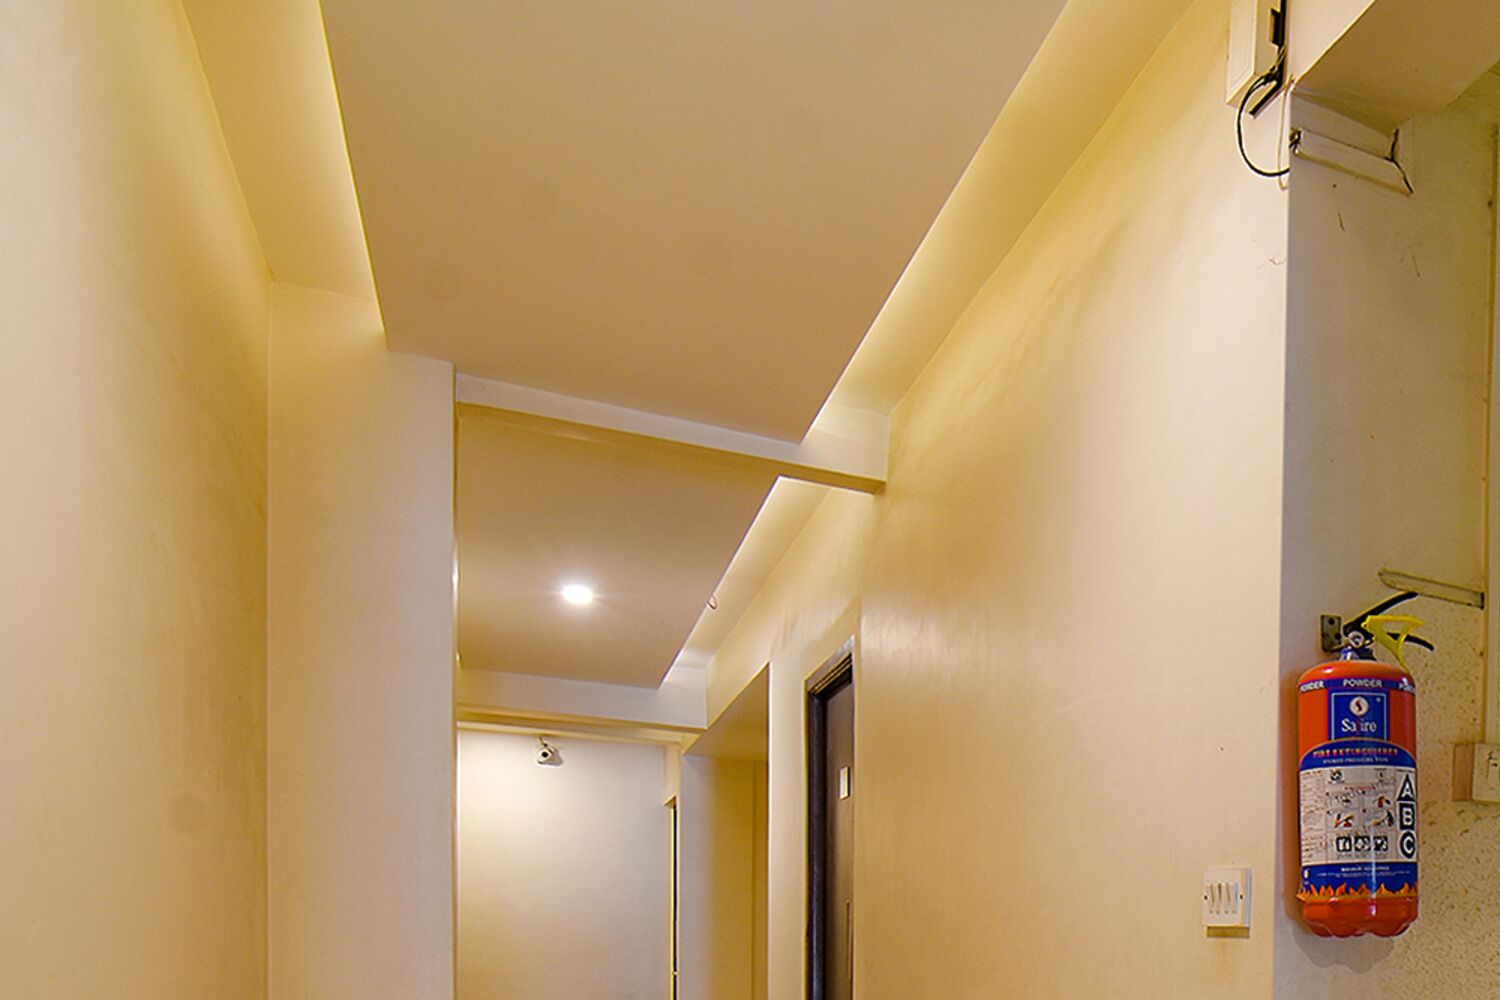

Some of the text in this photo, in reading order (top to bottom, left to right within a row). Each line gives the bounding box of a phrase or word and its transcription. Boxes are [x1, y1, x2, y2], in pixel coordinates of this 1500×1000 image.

[1342, 679, 1383, 688] POWDER
[1401, 782, 1414, 798] A
[1402, 807, 1414, 827] B
[1403, 836, 1414, 855] C
